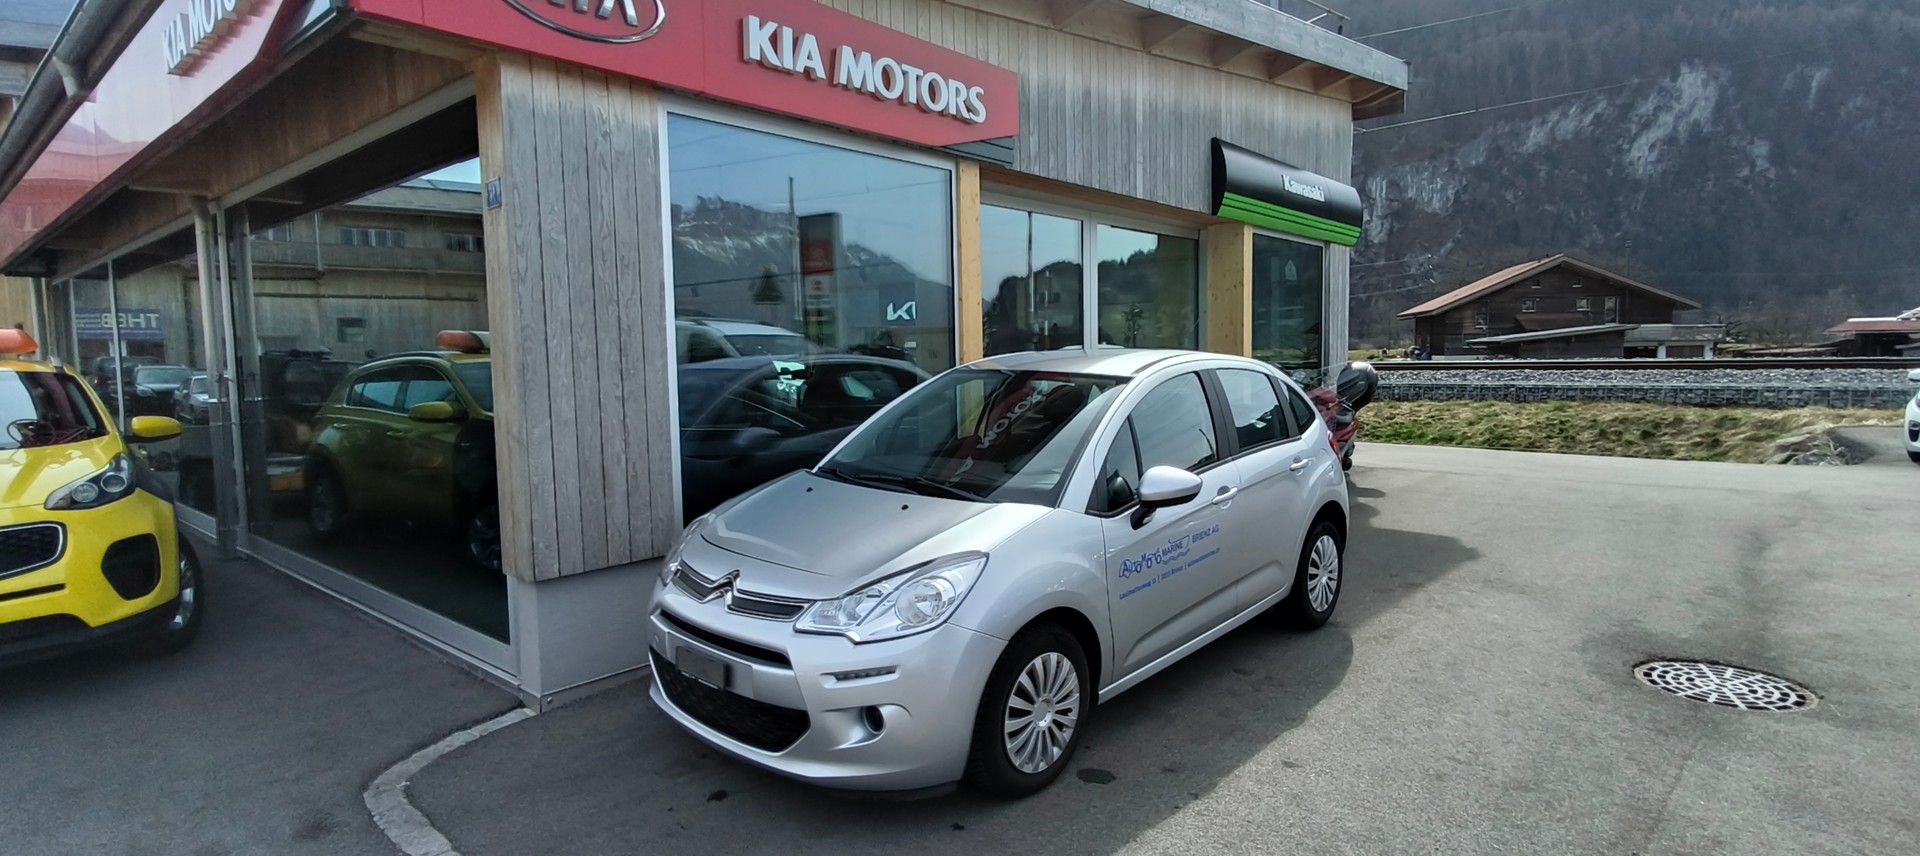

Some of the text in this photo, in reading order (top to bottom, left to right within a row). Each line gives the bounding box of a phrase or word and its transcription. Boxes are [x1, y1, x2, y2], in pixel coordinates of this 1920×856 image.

[162, 12, 188, 74] KIA
[743, 15, 987, 124] KIA MOTORS
[1281, 174, 1326, 203] Kawasaki
[1161, 540, 1184, 557] MARINE
[1192, 529, 1212, 543] BRIENZ
[1212, 524, 1220, 534] AG
